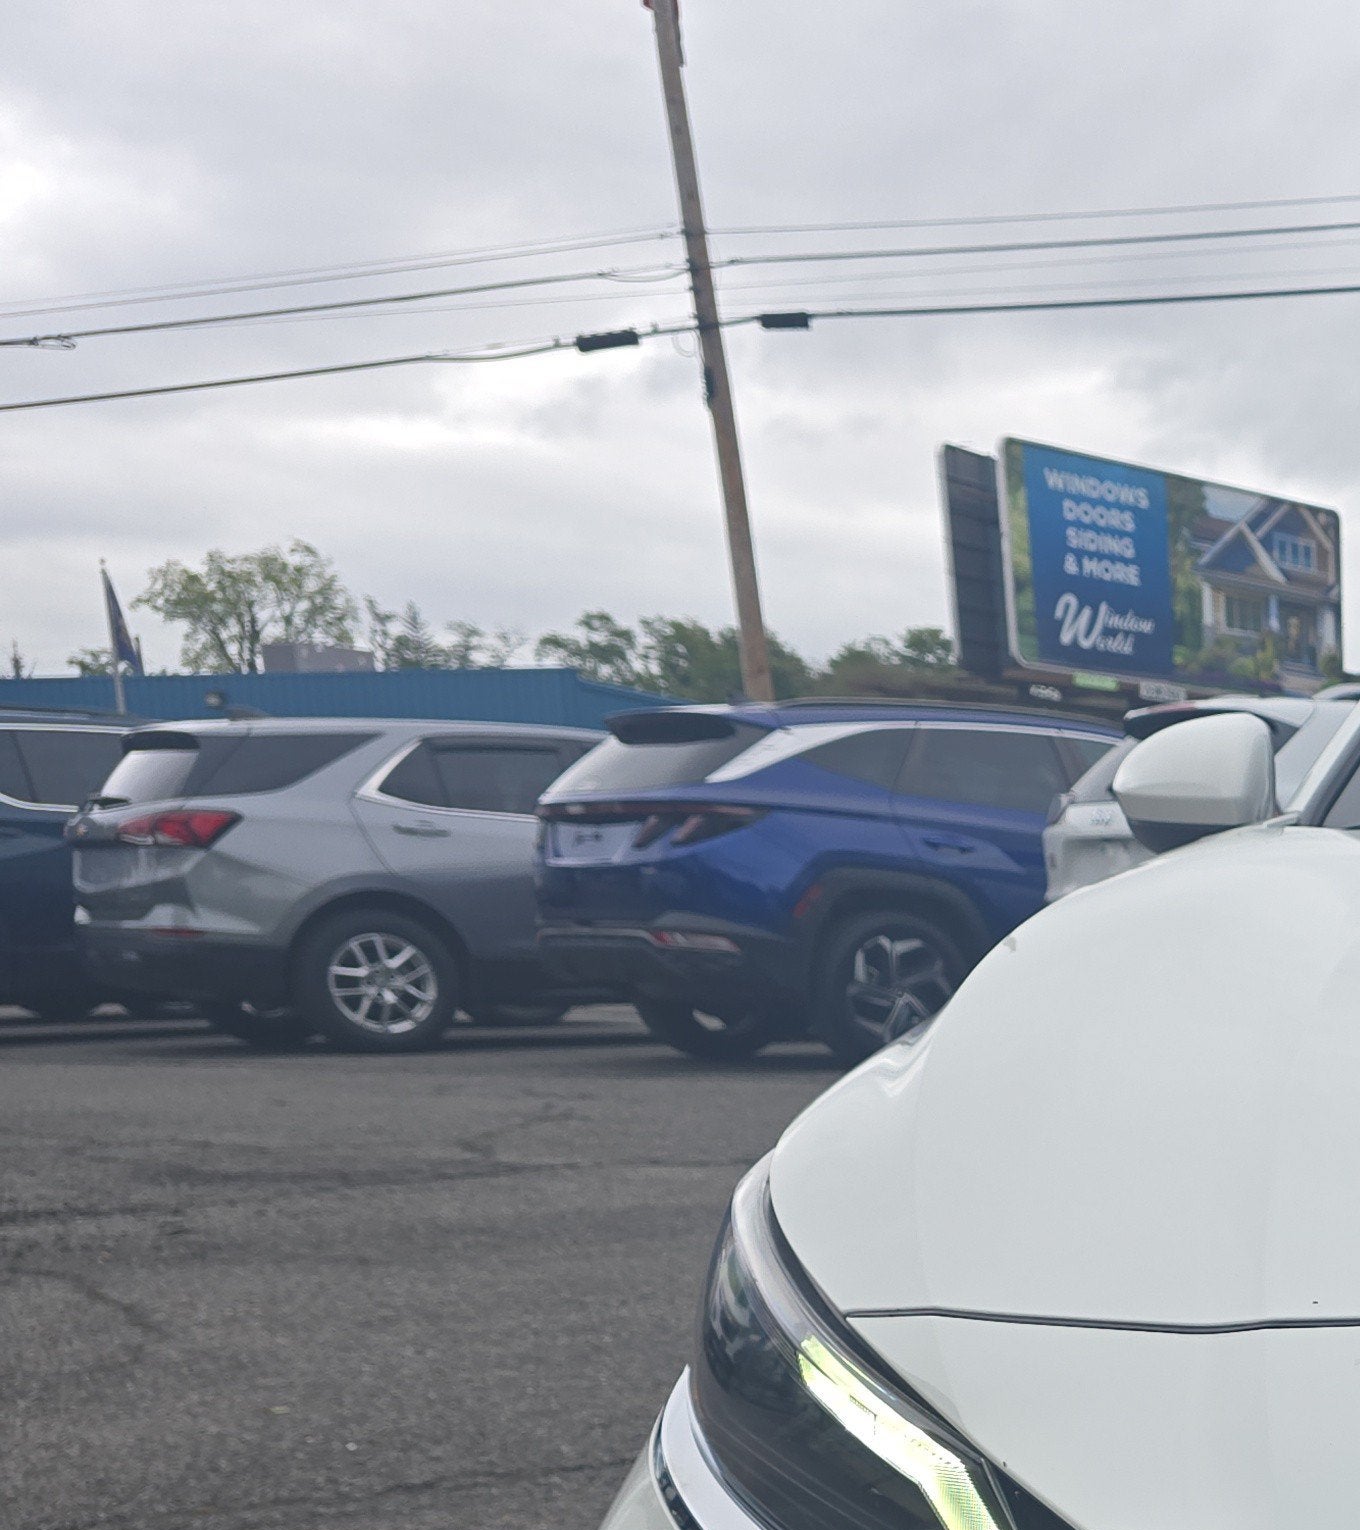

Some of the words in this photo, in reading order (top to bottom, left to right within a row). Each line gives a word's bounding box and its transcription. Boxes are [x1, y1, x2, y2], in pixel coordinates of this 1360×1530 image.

[1043, 467, 1149, 509] WINDOWS
[1062, 498, 1135, 532] DOORS
[1065, 526, 1135, 558] SIDING
[1063, 552, 1079, 575] &
[1082, 555, 1142, 586] MORE
[1054, 592, 1155, 650] Window
